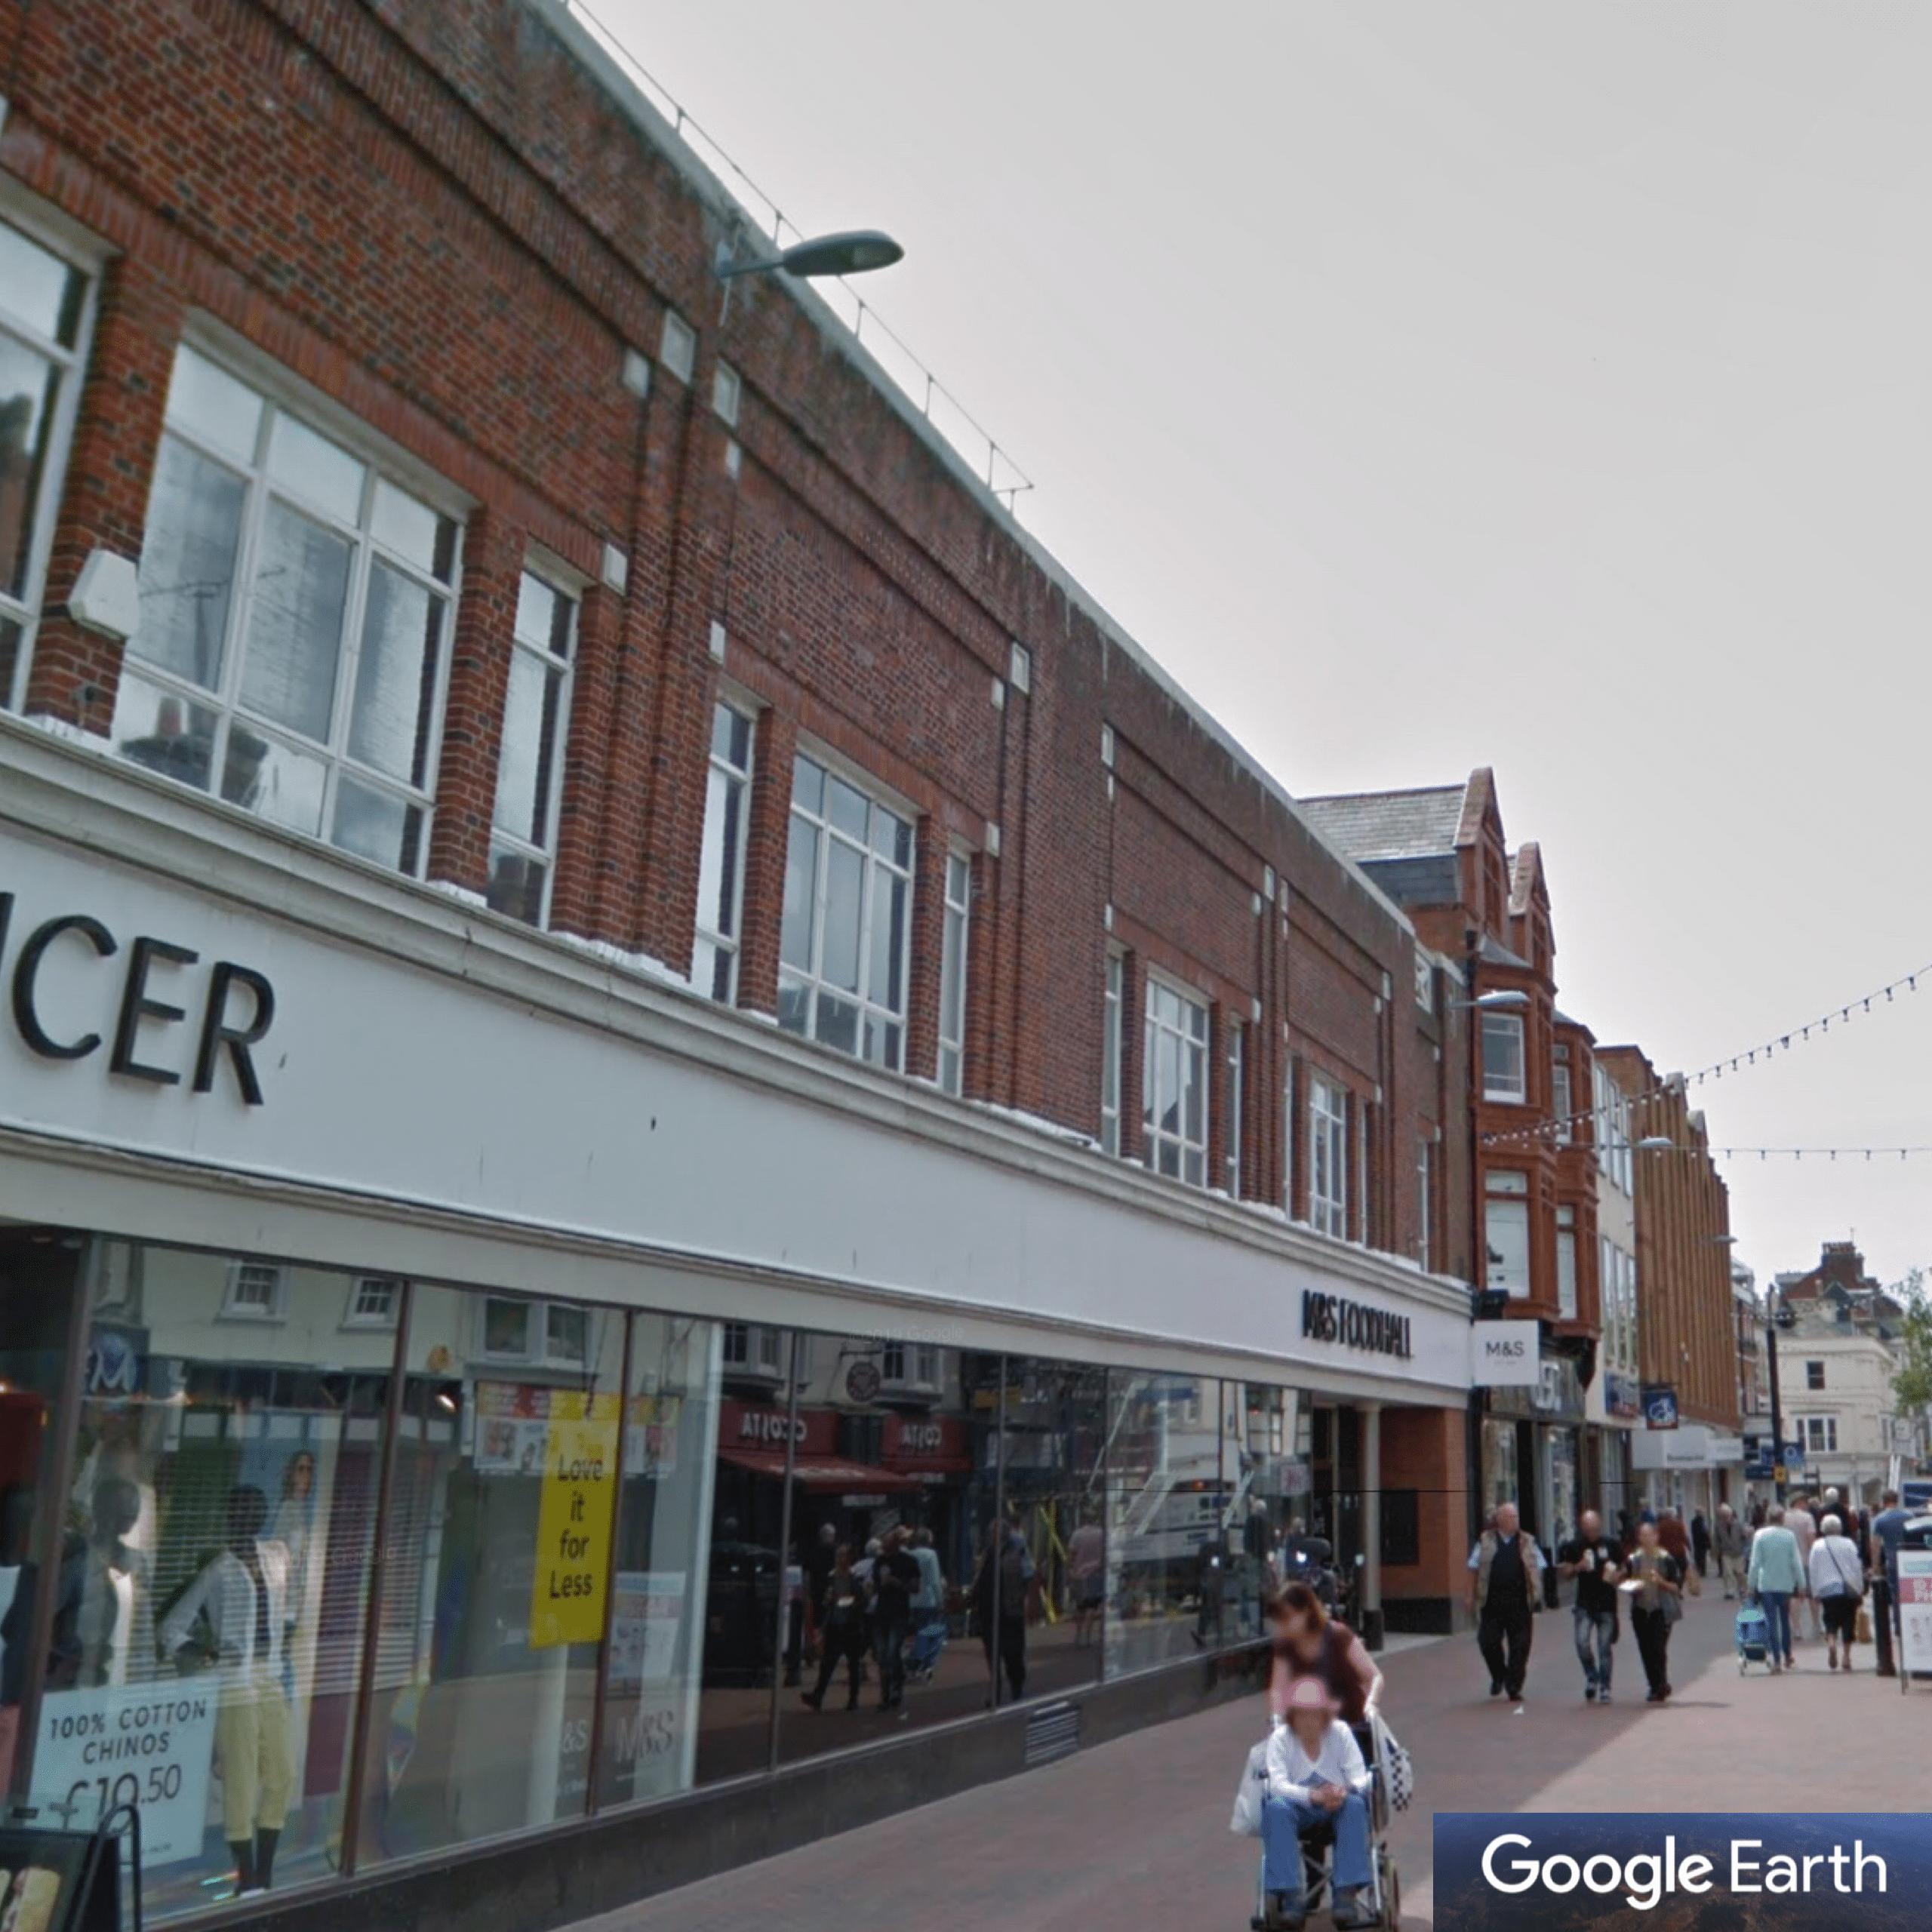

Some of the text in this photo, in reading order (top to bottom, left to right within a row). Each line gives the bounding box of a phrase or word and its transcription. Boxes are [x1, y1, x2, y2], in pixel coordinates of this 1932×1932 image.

[0, 892, 275, 1106] CER
[1485, 1340, 1524, 1357] M&S
[557, 1454, 603, 1482] Love
[570, 1491, 585, 1523] it
[559, 1528, 590, 1560] for
[549, 1570, 594, 1599] Less
[50, 1699, 207, 1740] 100% COTTON
[82, 1730, 171, 1764] CHINOS
